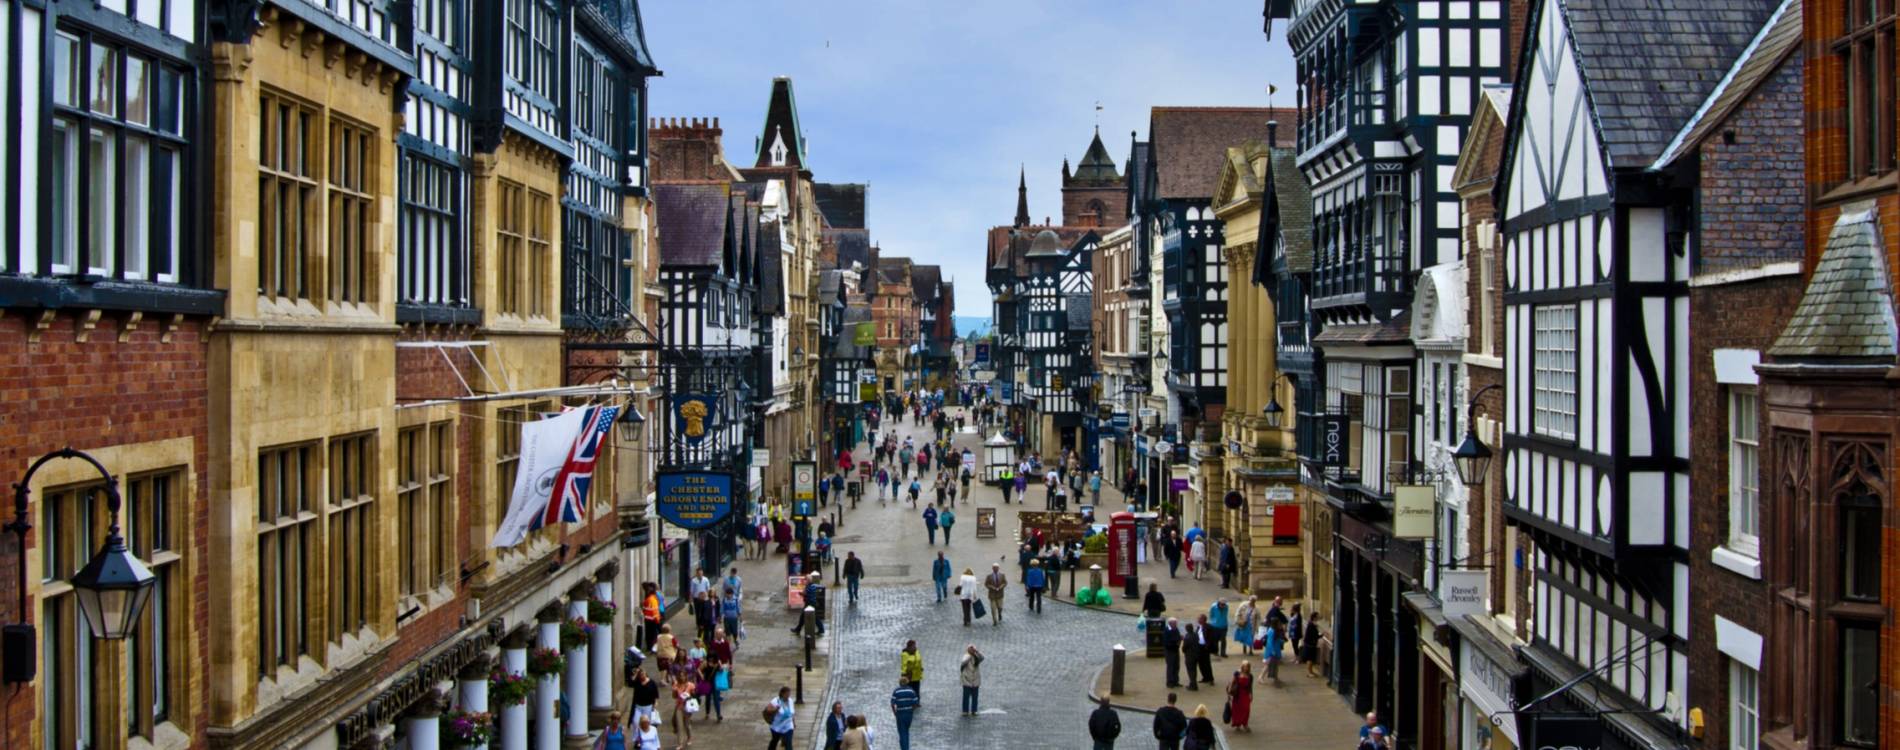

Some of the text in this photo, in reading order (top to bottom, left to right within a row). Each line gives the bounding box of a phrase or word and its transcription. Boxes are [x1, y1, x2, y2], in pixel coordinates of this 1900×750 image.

[1327, 421, 1340, 462] next
[684, 476, 705, 484] THE
[671, 486, 720, 494] CHESTER
[663, 495, 727, 504] GROSVENOR
[676, 504, 717, 512] AND SPA
[1451, 585, 1479, 594] Russell
[337, 711, 368, 749] THE
[368, 674, 419, 730] CHESTER
